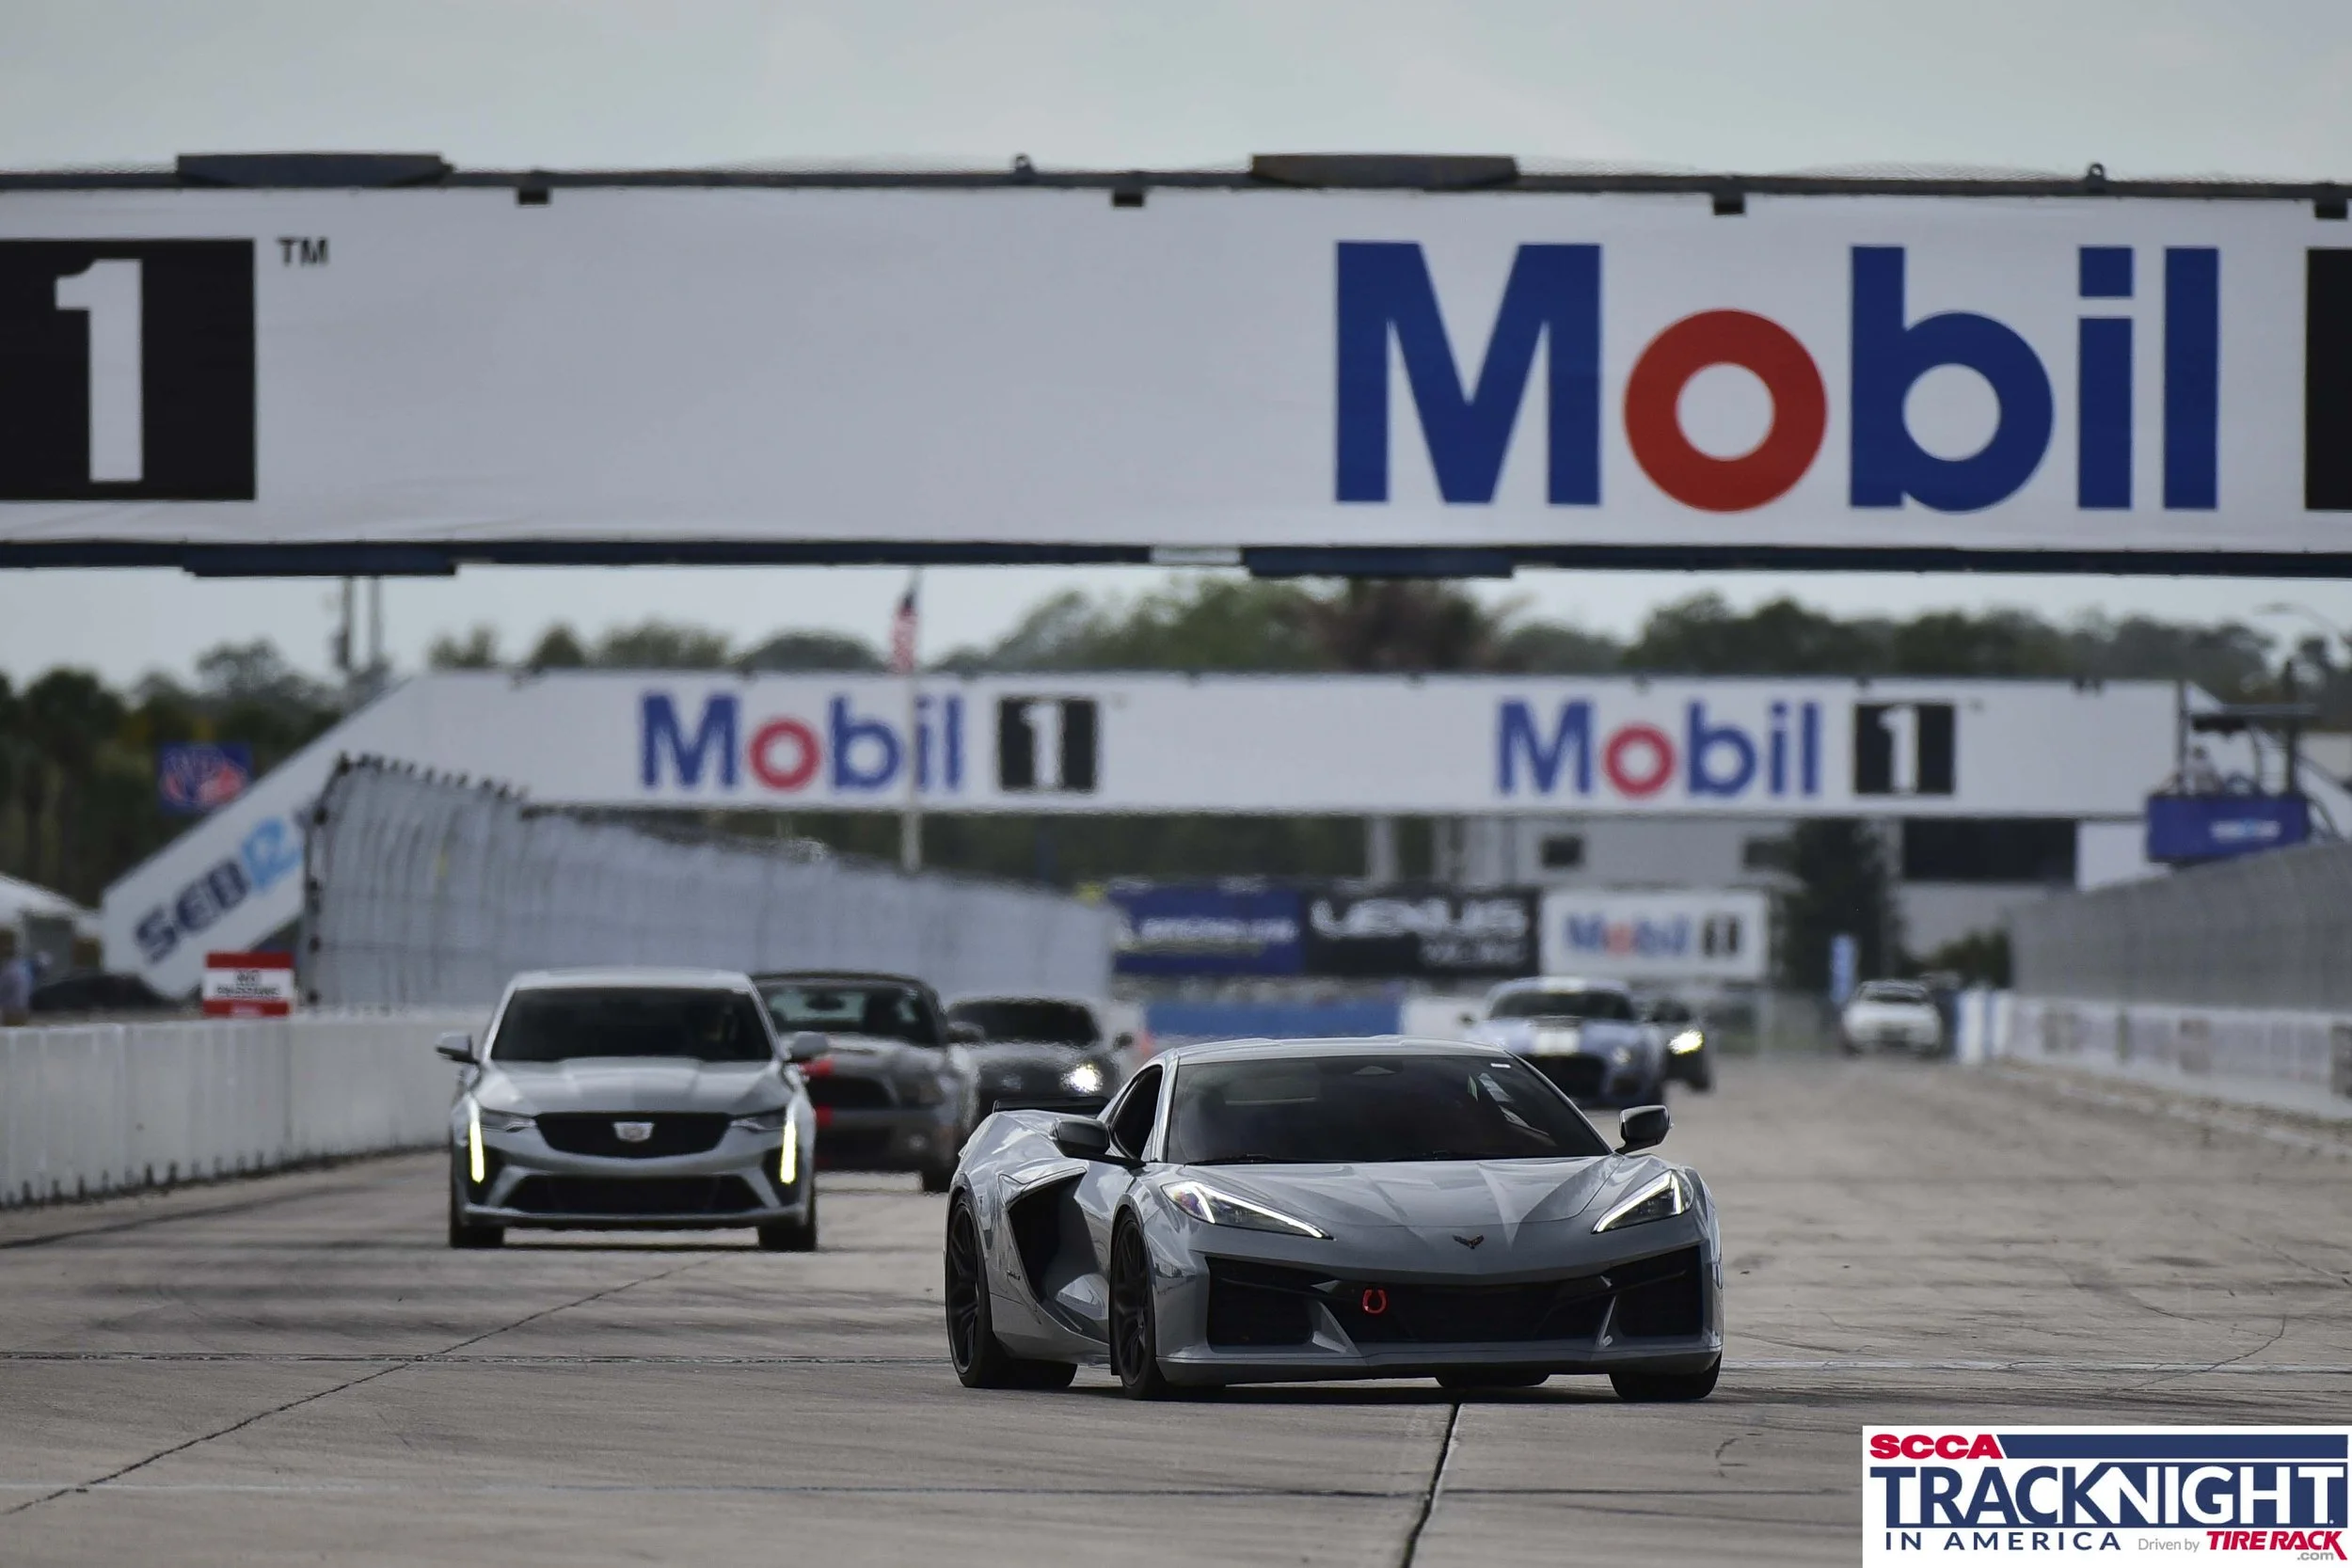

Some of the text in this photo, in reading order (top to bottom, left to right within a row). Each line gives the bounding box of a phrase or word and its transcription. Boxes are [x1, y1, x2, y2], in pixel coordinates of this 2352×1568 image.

[55, 237, 328, 483] 1 TM
[1335, 241, 2219, 513] Mobil
[640, 693, 963, 793] Mobil
[1498, 699, 1820, 799] Mobil
